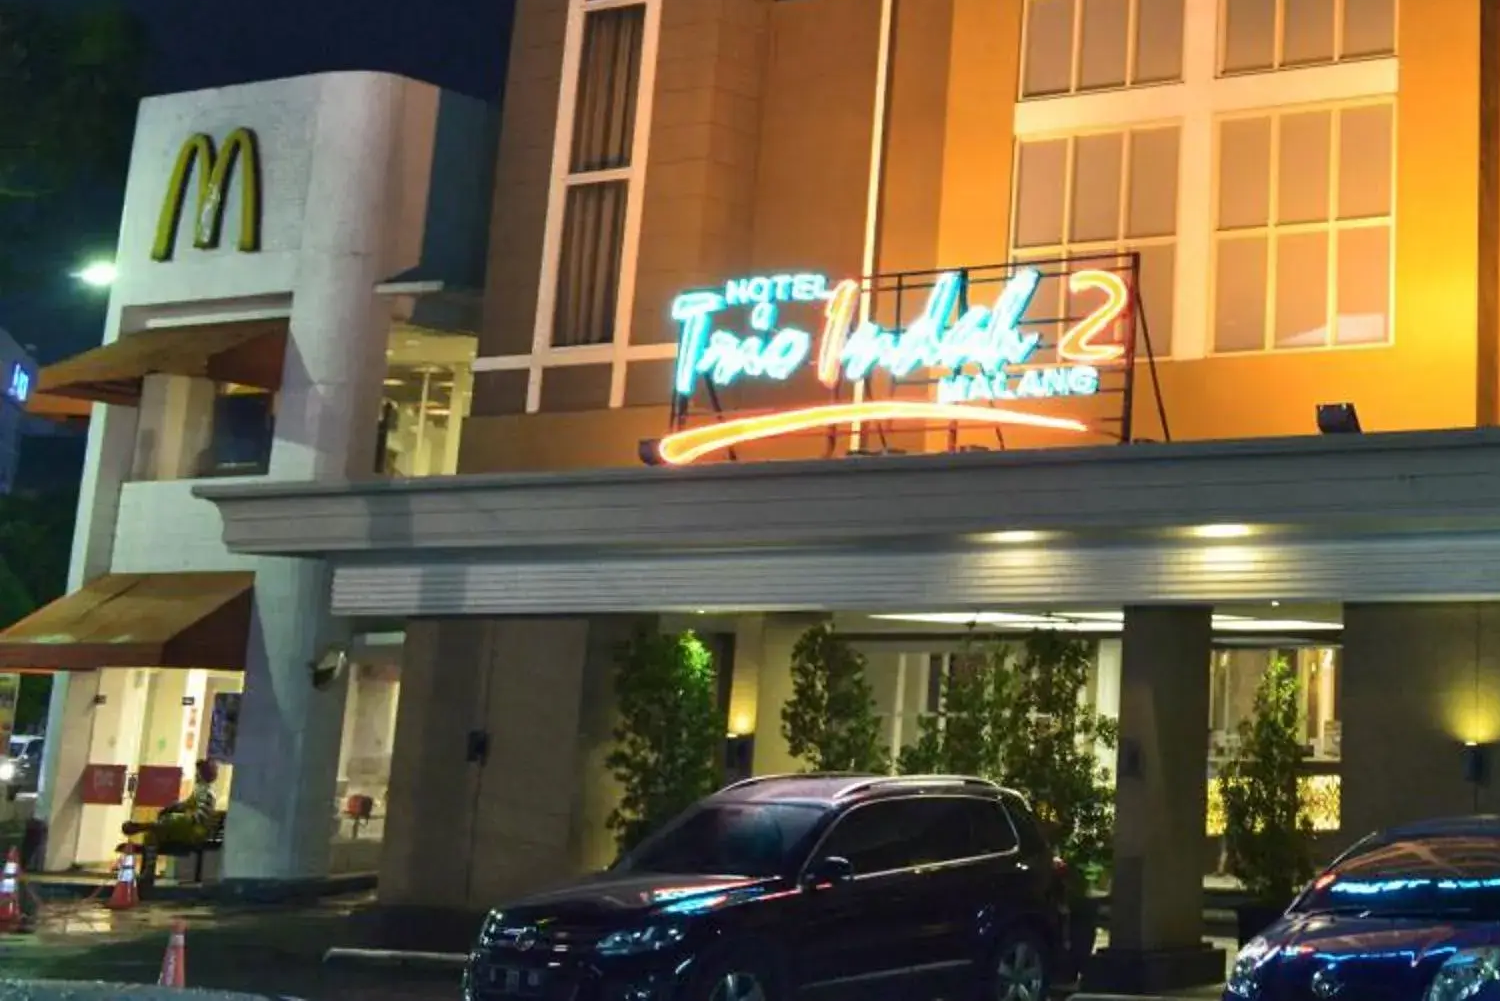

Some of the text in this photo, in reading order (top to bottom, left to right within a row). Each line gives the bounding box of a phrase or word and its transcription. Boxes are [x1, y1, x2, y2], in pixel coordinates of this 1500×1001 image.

[724, 273, 830, 304] HOTEL
[670, 267, 1130, 397] Trio Indah 2
[937, 365, 1100, 404] MALANG
